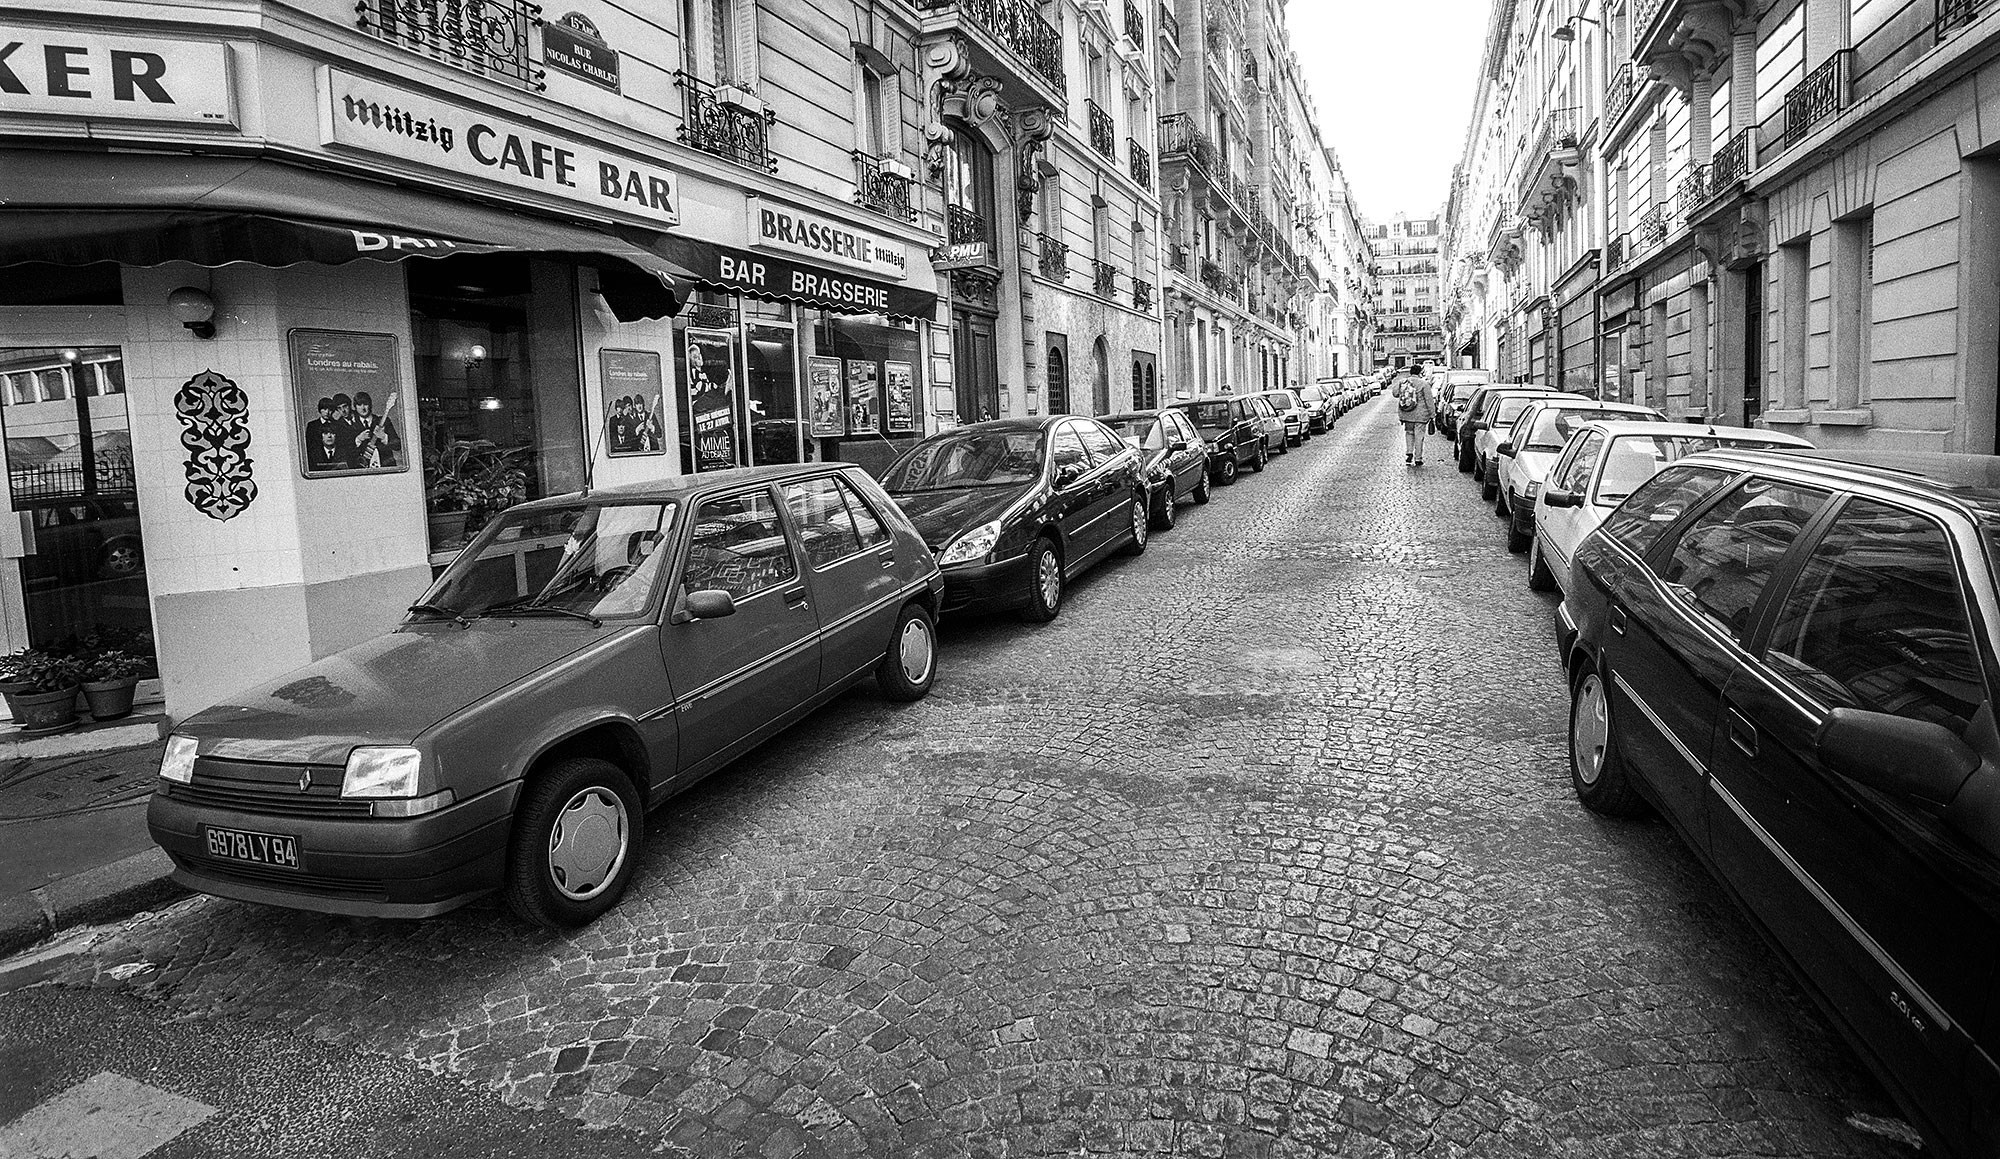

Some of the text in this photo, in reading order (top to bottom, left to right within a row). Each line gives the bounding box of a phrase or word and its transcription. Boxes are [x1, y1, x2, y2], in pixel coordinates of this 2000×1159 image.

[546, 47, 618, 84] NICOLAS CHARLET
[573, 43, 592, 60] RUE
[466, 123, 576, 188] CAFE
[598, 160, 674, 214] BAR
[760, 207, 872, 264] BRASSERIE
[950, 243, 981, 259] PMU
[719, 255, 889, 309] BAR BRASSERIE
[307, 358, 341, 367] Londres
